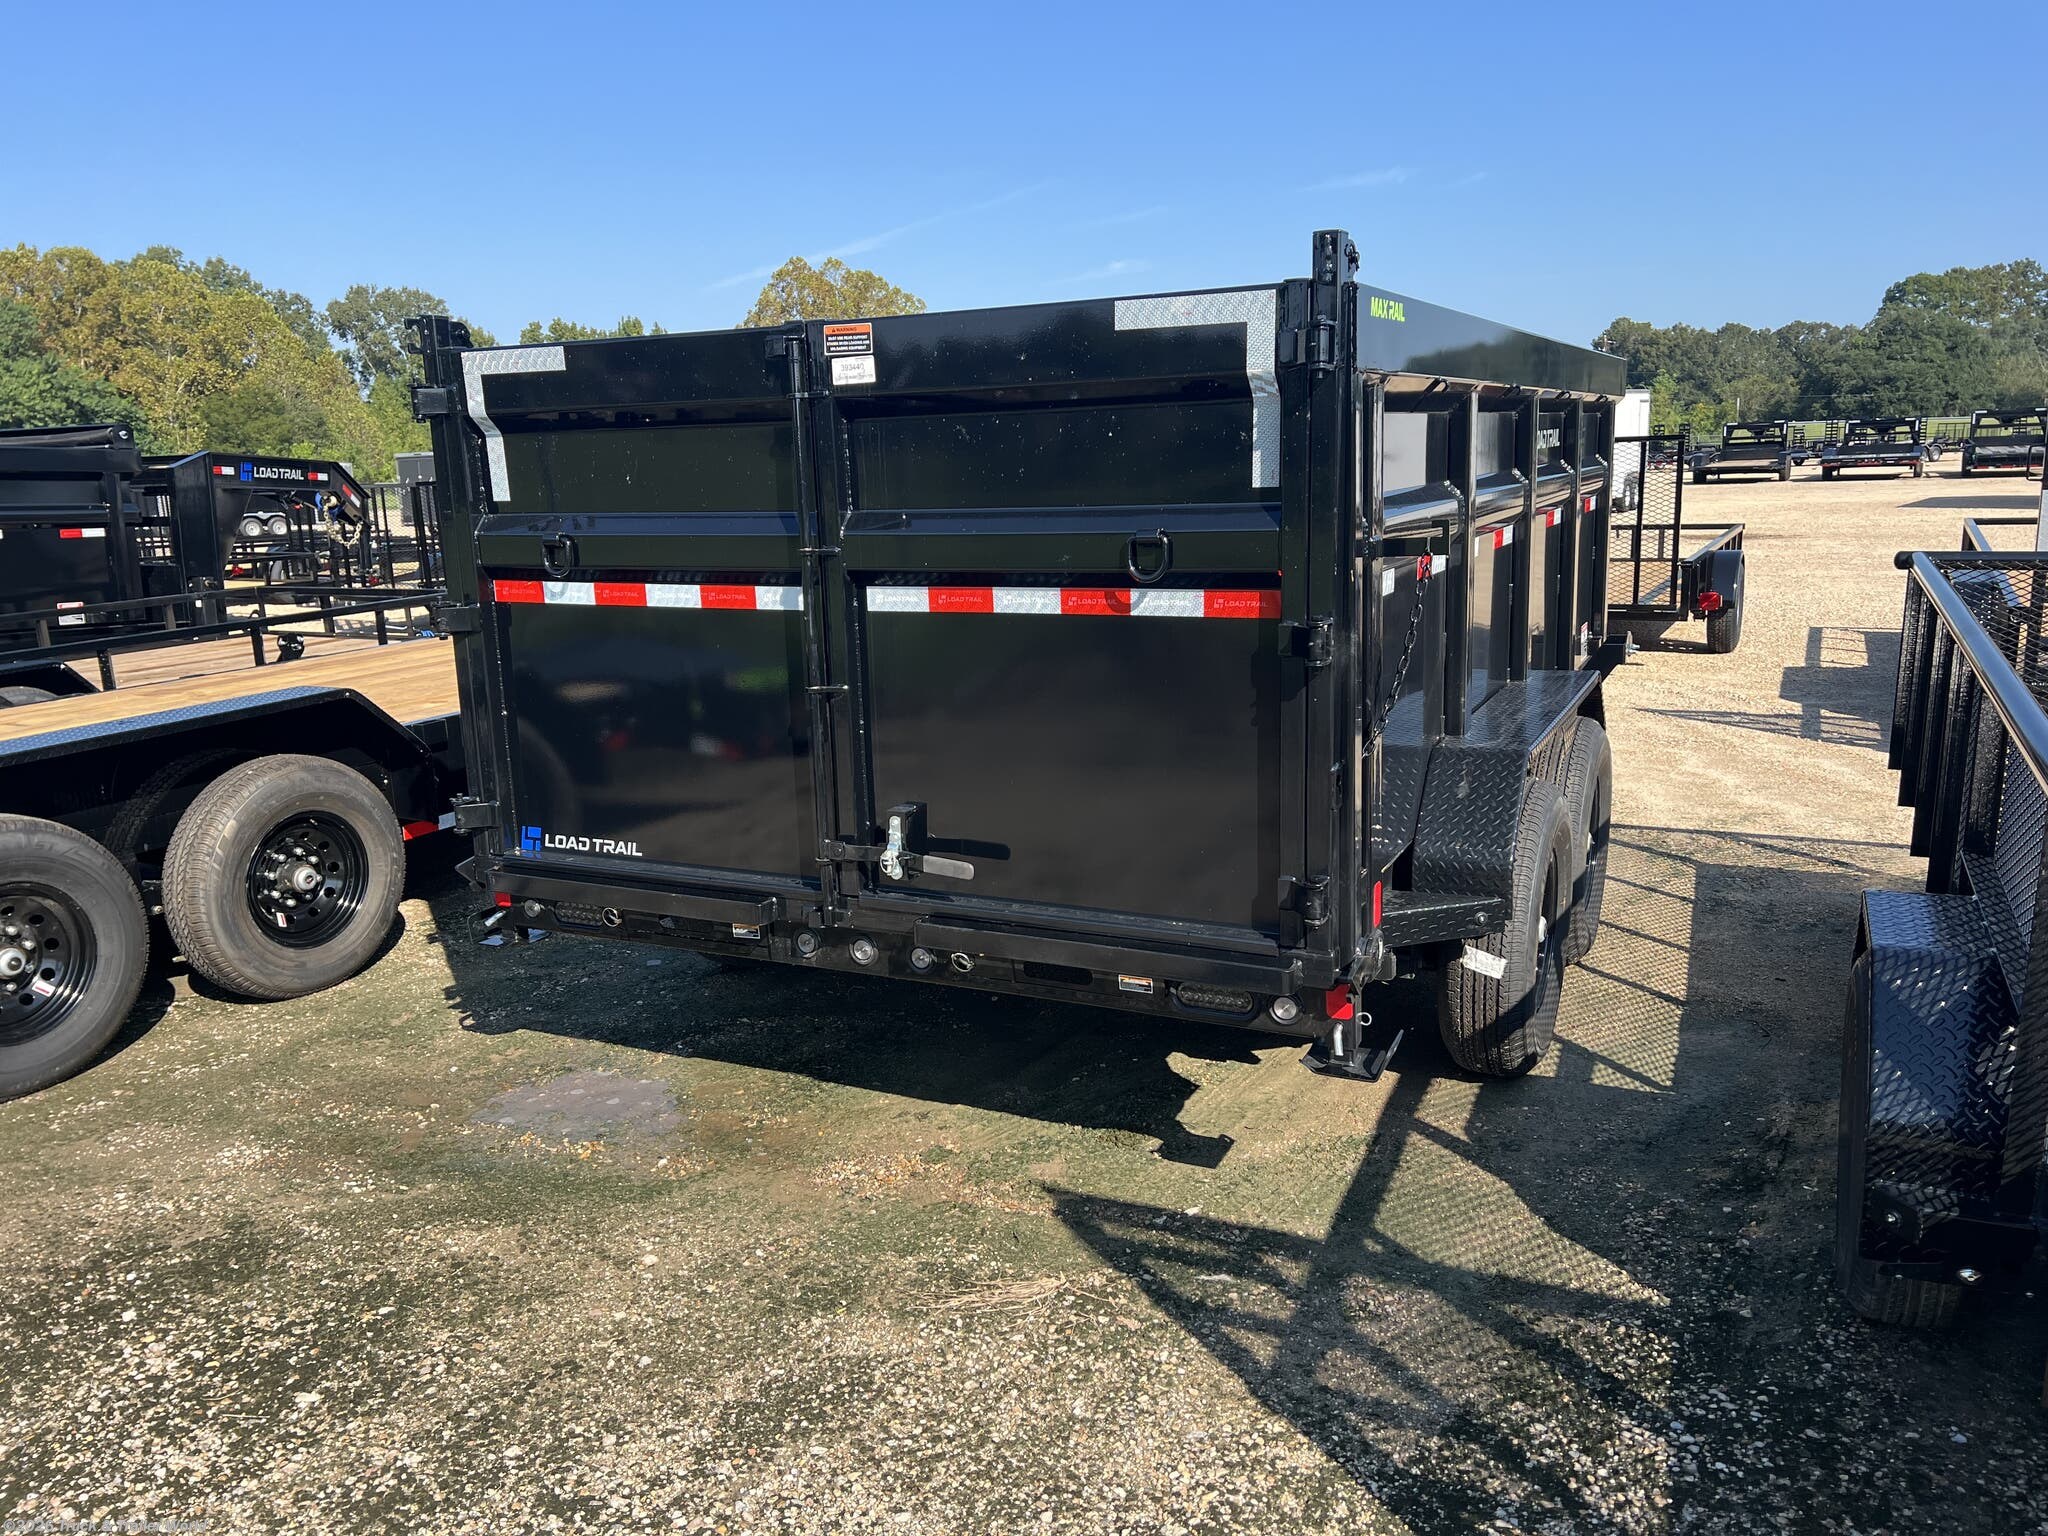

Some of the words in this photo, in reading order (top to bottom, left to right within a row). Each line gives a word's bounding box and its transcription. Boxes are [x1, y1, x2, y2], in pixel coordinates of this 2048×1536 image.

[1370, 296, 1388, 320] MAX
[1389, 300, 1405, 322] RAIL
[253, 466, 279, 479] LOAD
[279, 468, 304, 480] TRAIL
[544, 833, 590, 851] LOAD
[592, 838, 643, 857] TRAIL
